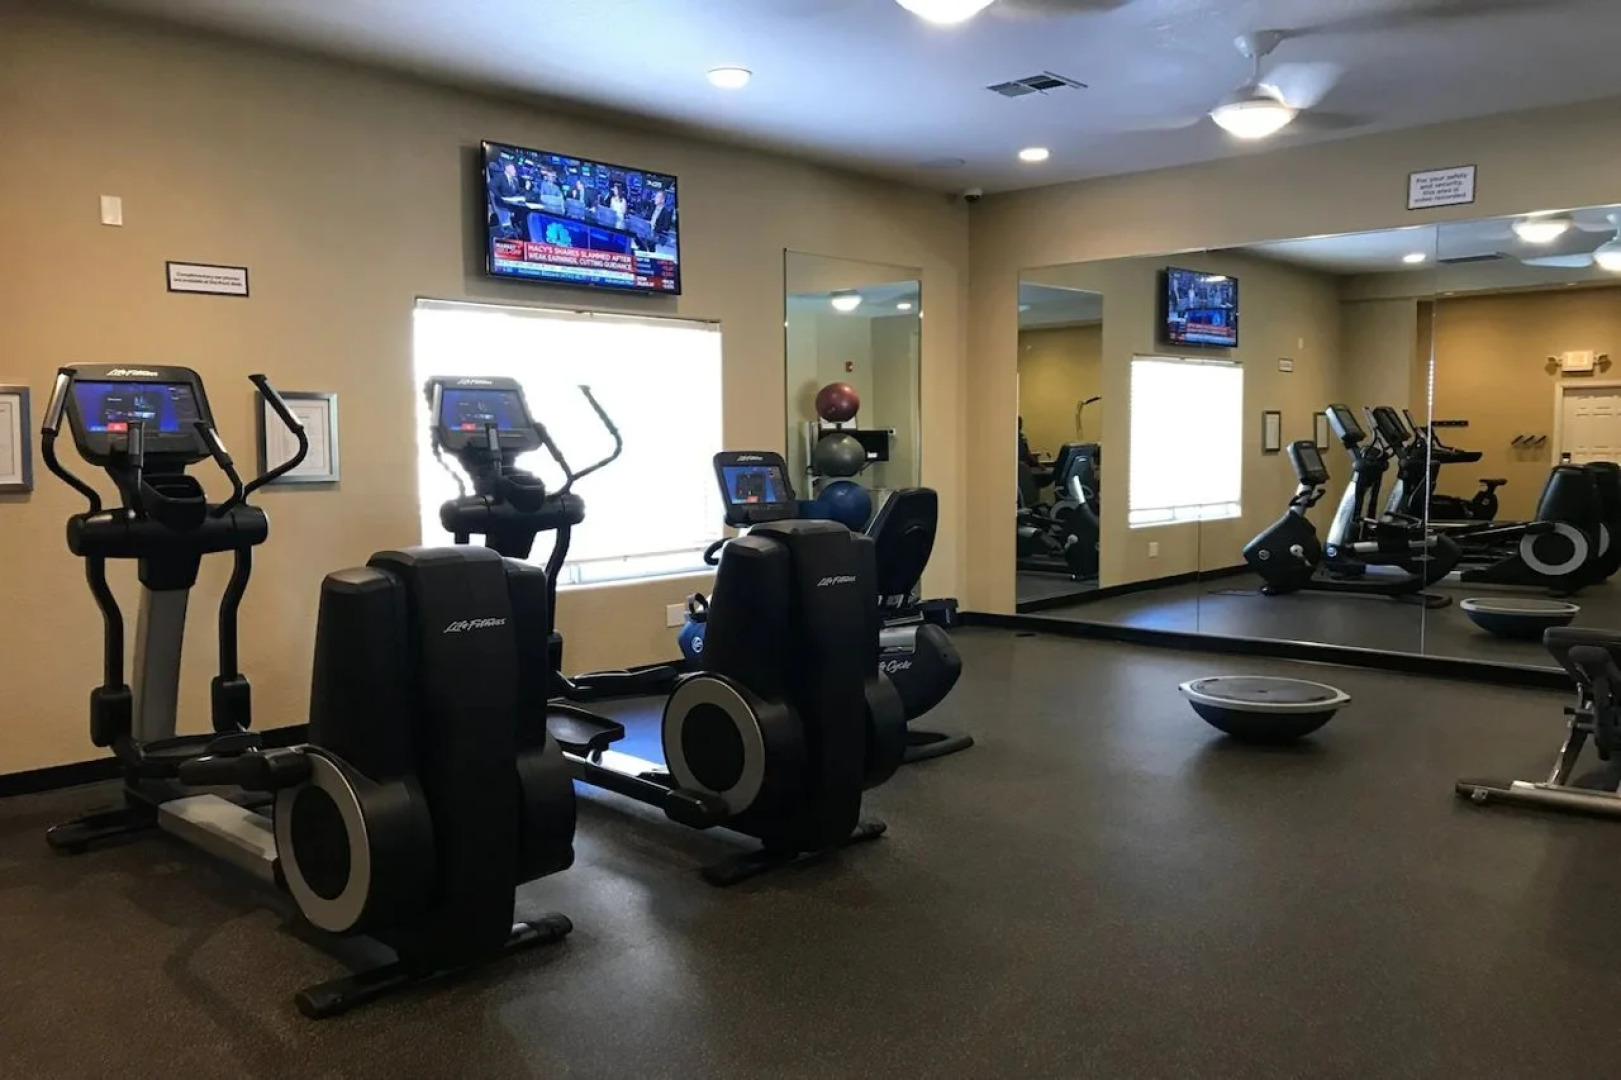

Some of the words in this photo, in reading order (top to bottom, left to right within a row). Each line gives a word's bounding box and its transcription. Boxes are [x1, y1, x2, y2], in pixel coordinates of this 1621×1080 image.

[528, 243, 553, 254] MACY'S
[554, 246, 579, 257] SHARES
[580, 249, 611, 261] SLAMMED
[612, 254, 631, 263] AFTER
[528, 252, 548, 262] WEAK
[579, 258, 603, 268] CUTTING
[604, 261, 632, 271] GUIDANCE
[443, 620, 469, 633] Life
[467, 618, 506, 631] Fitness
